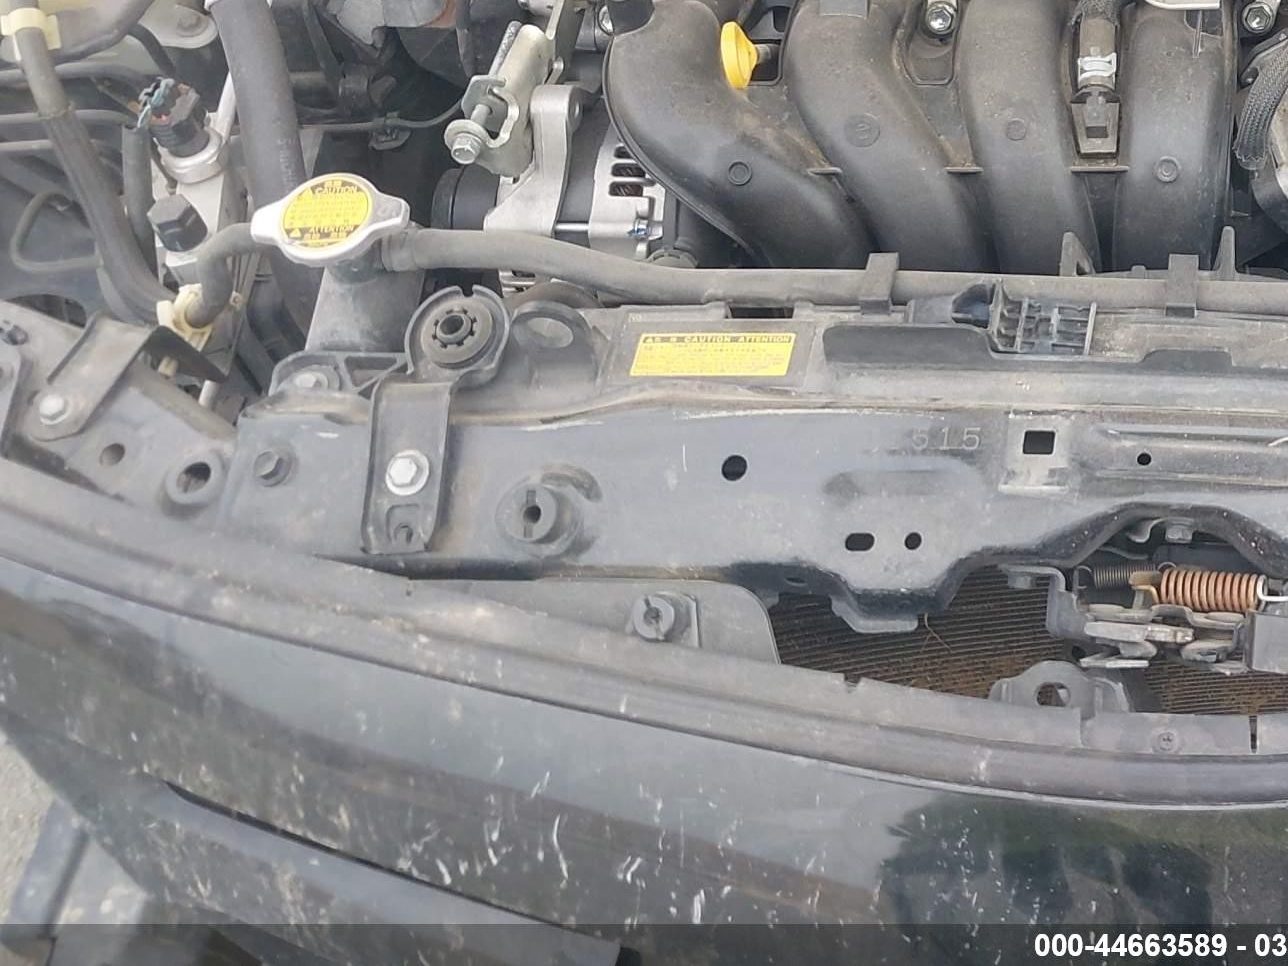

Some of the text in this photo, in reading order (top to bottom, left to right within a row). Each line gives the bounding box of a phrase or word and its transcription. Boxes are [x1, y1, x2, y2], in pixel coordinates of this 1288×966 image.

[315, 185, 358, 195] CAUTION
[309, 225, 355, 234] ATTENTION
[684, 336, 732, 344] CAUTION
[736, 336, 792, 344] ATTENTION
